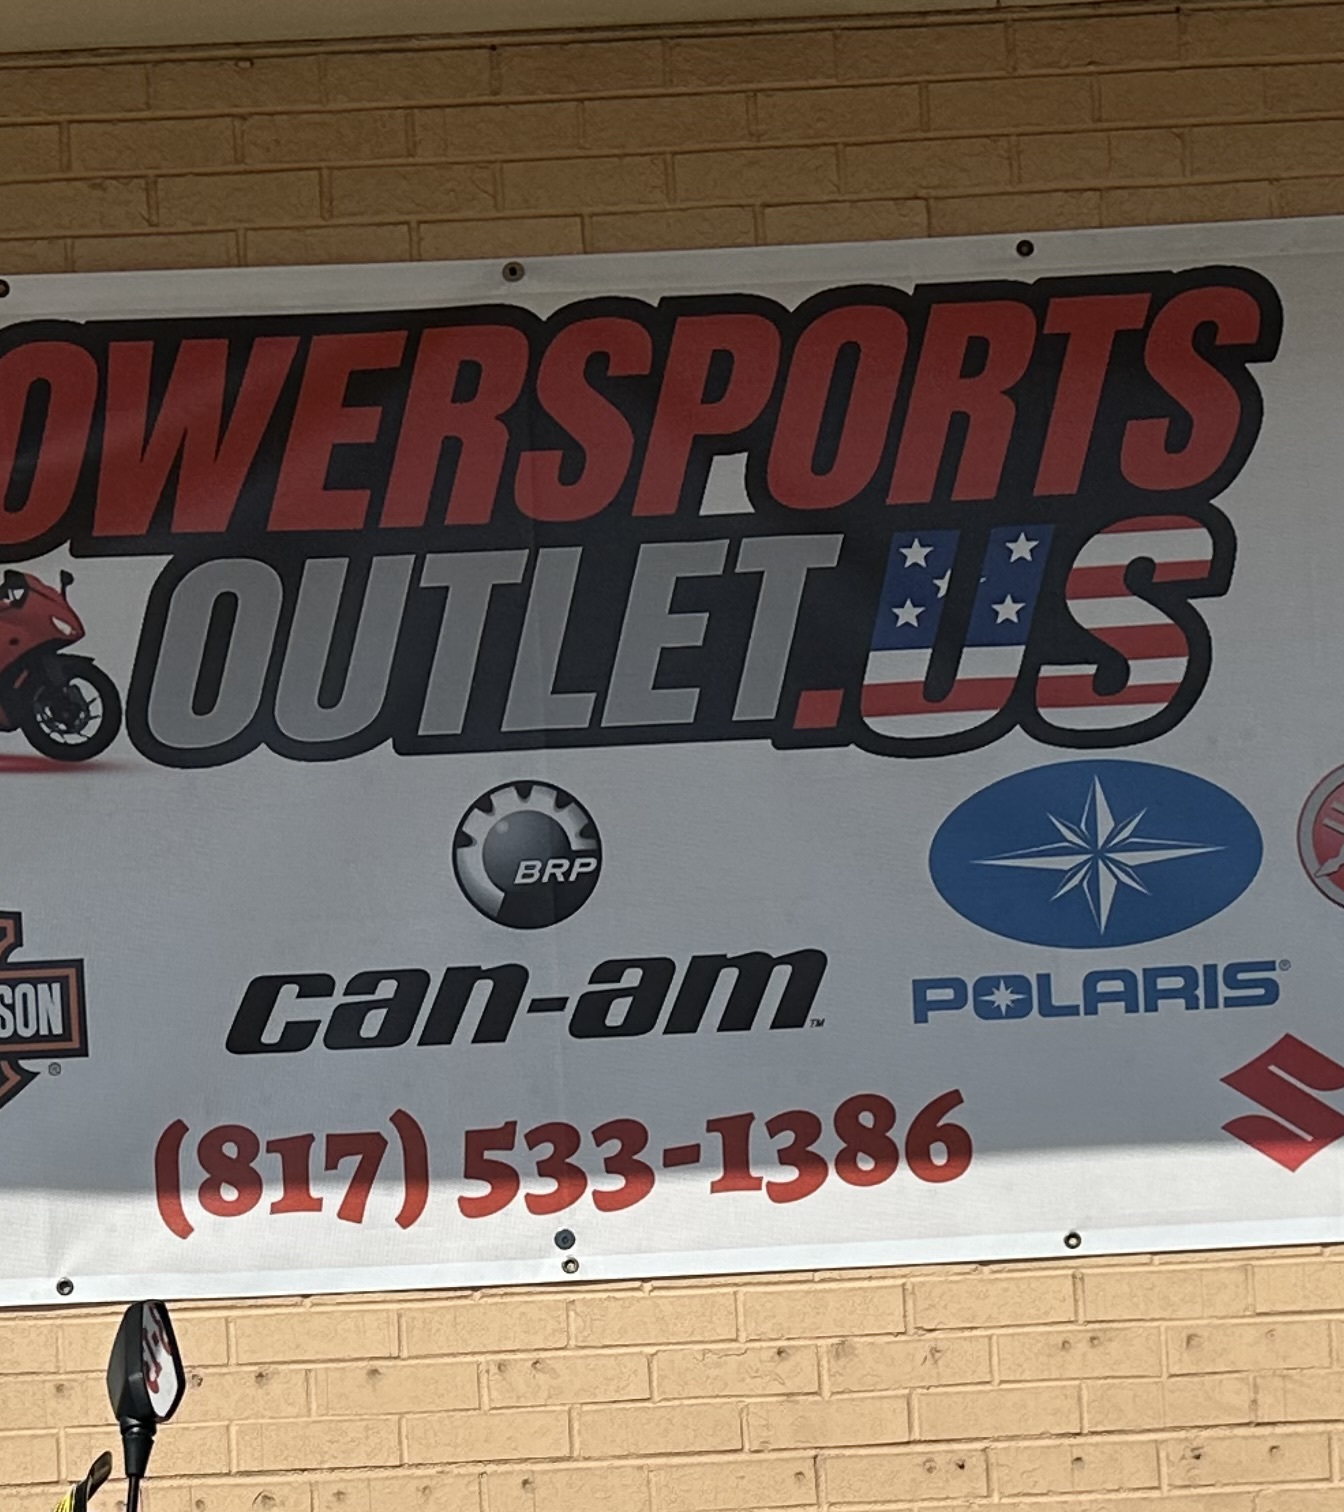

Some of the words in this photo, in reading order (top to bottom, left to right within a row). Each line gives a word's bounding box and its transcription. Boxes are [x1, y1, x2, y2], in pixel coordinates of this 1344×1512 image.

[146, 513, 1216, 751] OUTLET.US
[513, 857, 598, 885] BRP
[224, 947, 829, 1056] can-am
[911, 959, 1282, 1025] POLARIS
[154, 1107, 430, 1241] (817)
[457, 1088, 974, 1220] 533-1386
